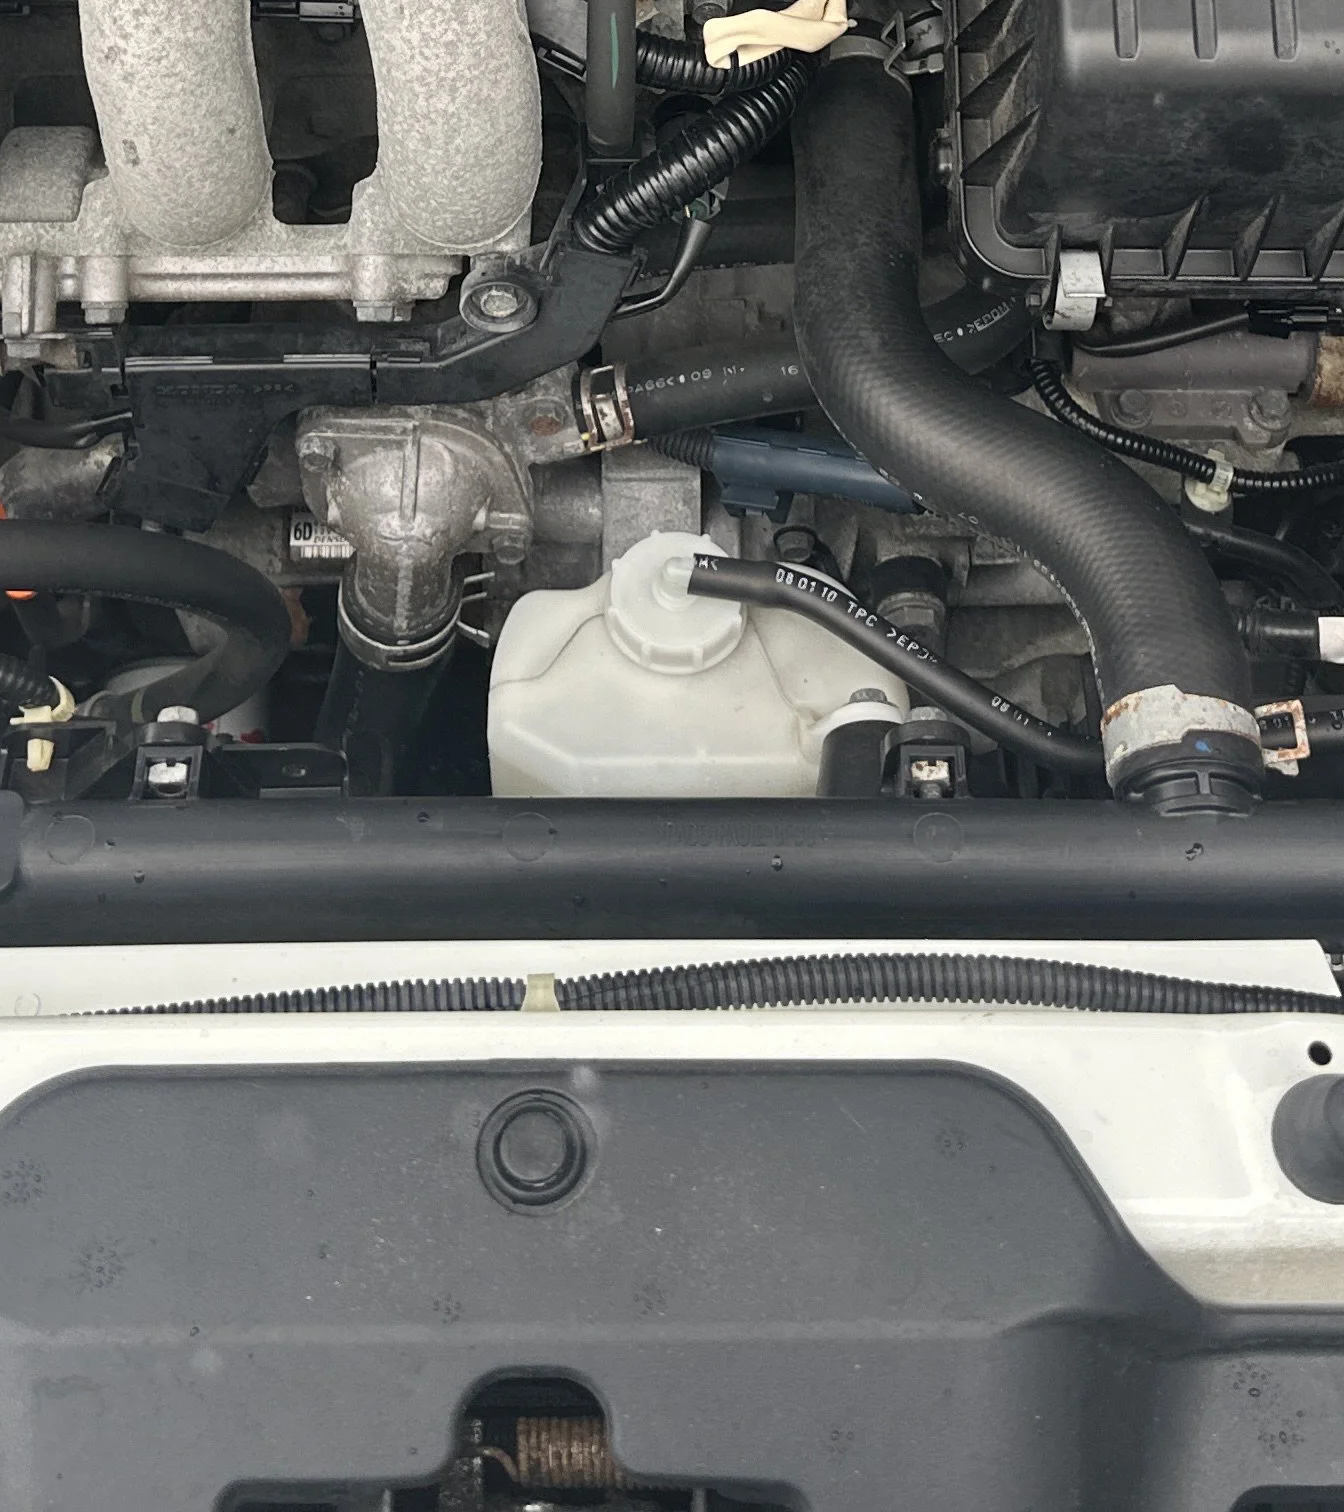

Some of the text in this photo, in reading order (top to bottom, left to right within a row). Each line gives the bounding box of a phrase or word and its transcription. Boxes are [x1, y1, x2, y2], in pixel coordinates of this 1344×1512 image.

[780, 364, 799, 377] 16
[293, 520, 313, 541] 6D
[774, 568, 794, 585] 08
[797, 577, 817, 593] 01
[820, 586, 838, 603] 10
[846, 600, 878, 628] TPC
